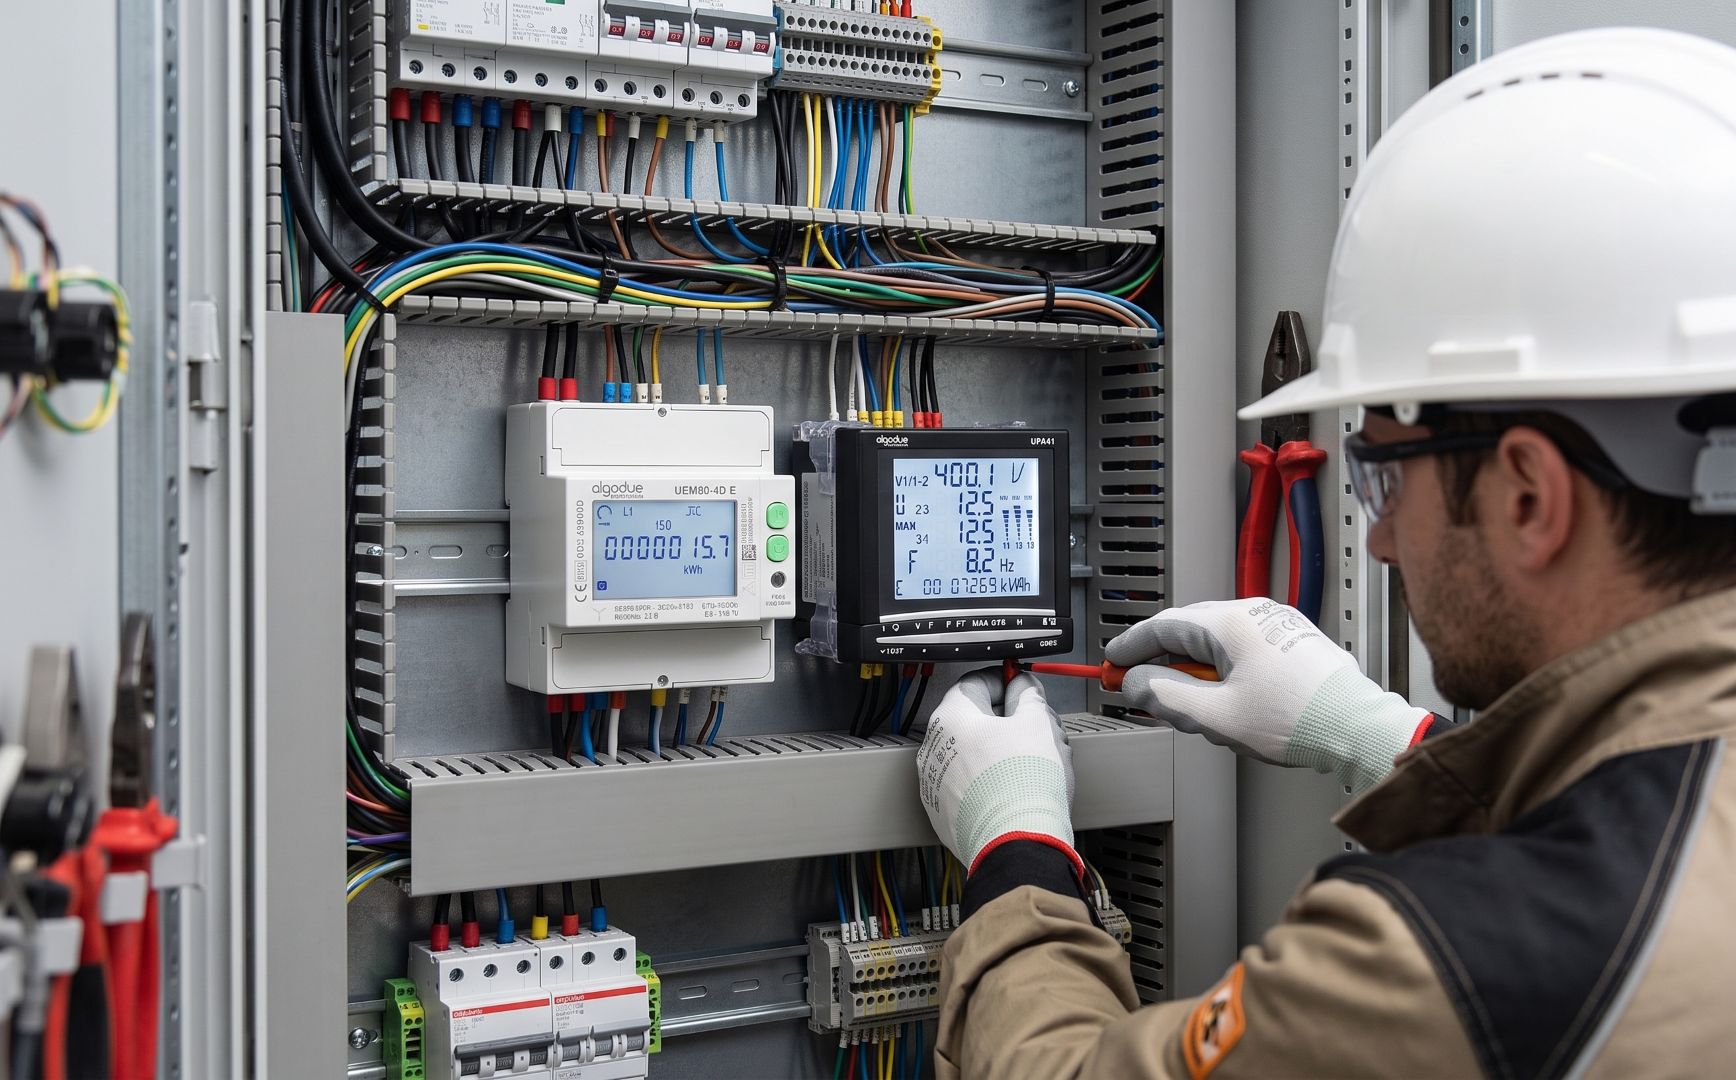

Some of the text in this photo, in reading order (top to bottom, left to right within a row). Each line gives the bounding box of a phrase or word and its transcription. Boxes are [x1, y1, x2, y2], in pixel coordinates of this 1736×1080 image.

[876, 435, 909, 446] algodue
[1030, 437, 1055, 445] UPA41
[591, 480, 644, 498] algodue
[674, 485, 737, 495] UEM80-4D E
[915, 504, 930, 515] 23
[958, 490, 994, 516] 12.5
[655, 519, 672, 531] 150
[958, 519, 995, 545] 12.5
[915, 533, 930, 545] 34
[908, 547, 1015, 575] F 8.2 Hz
[683, 564, 703, 575] kWh
